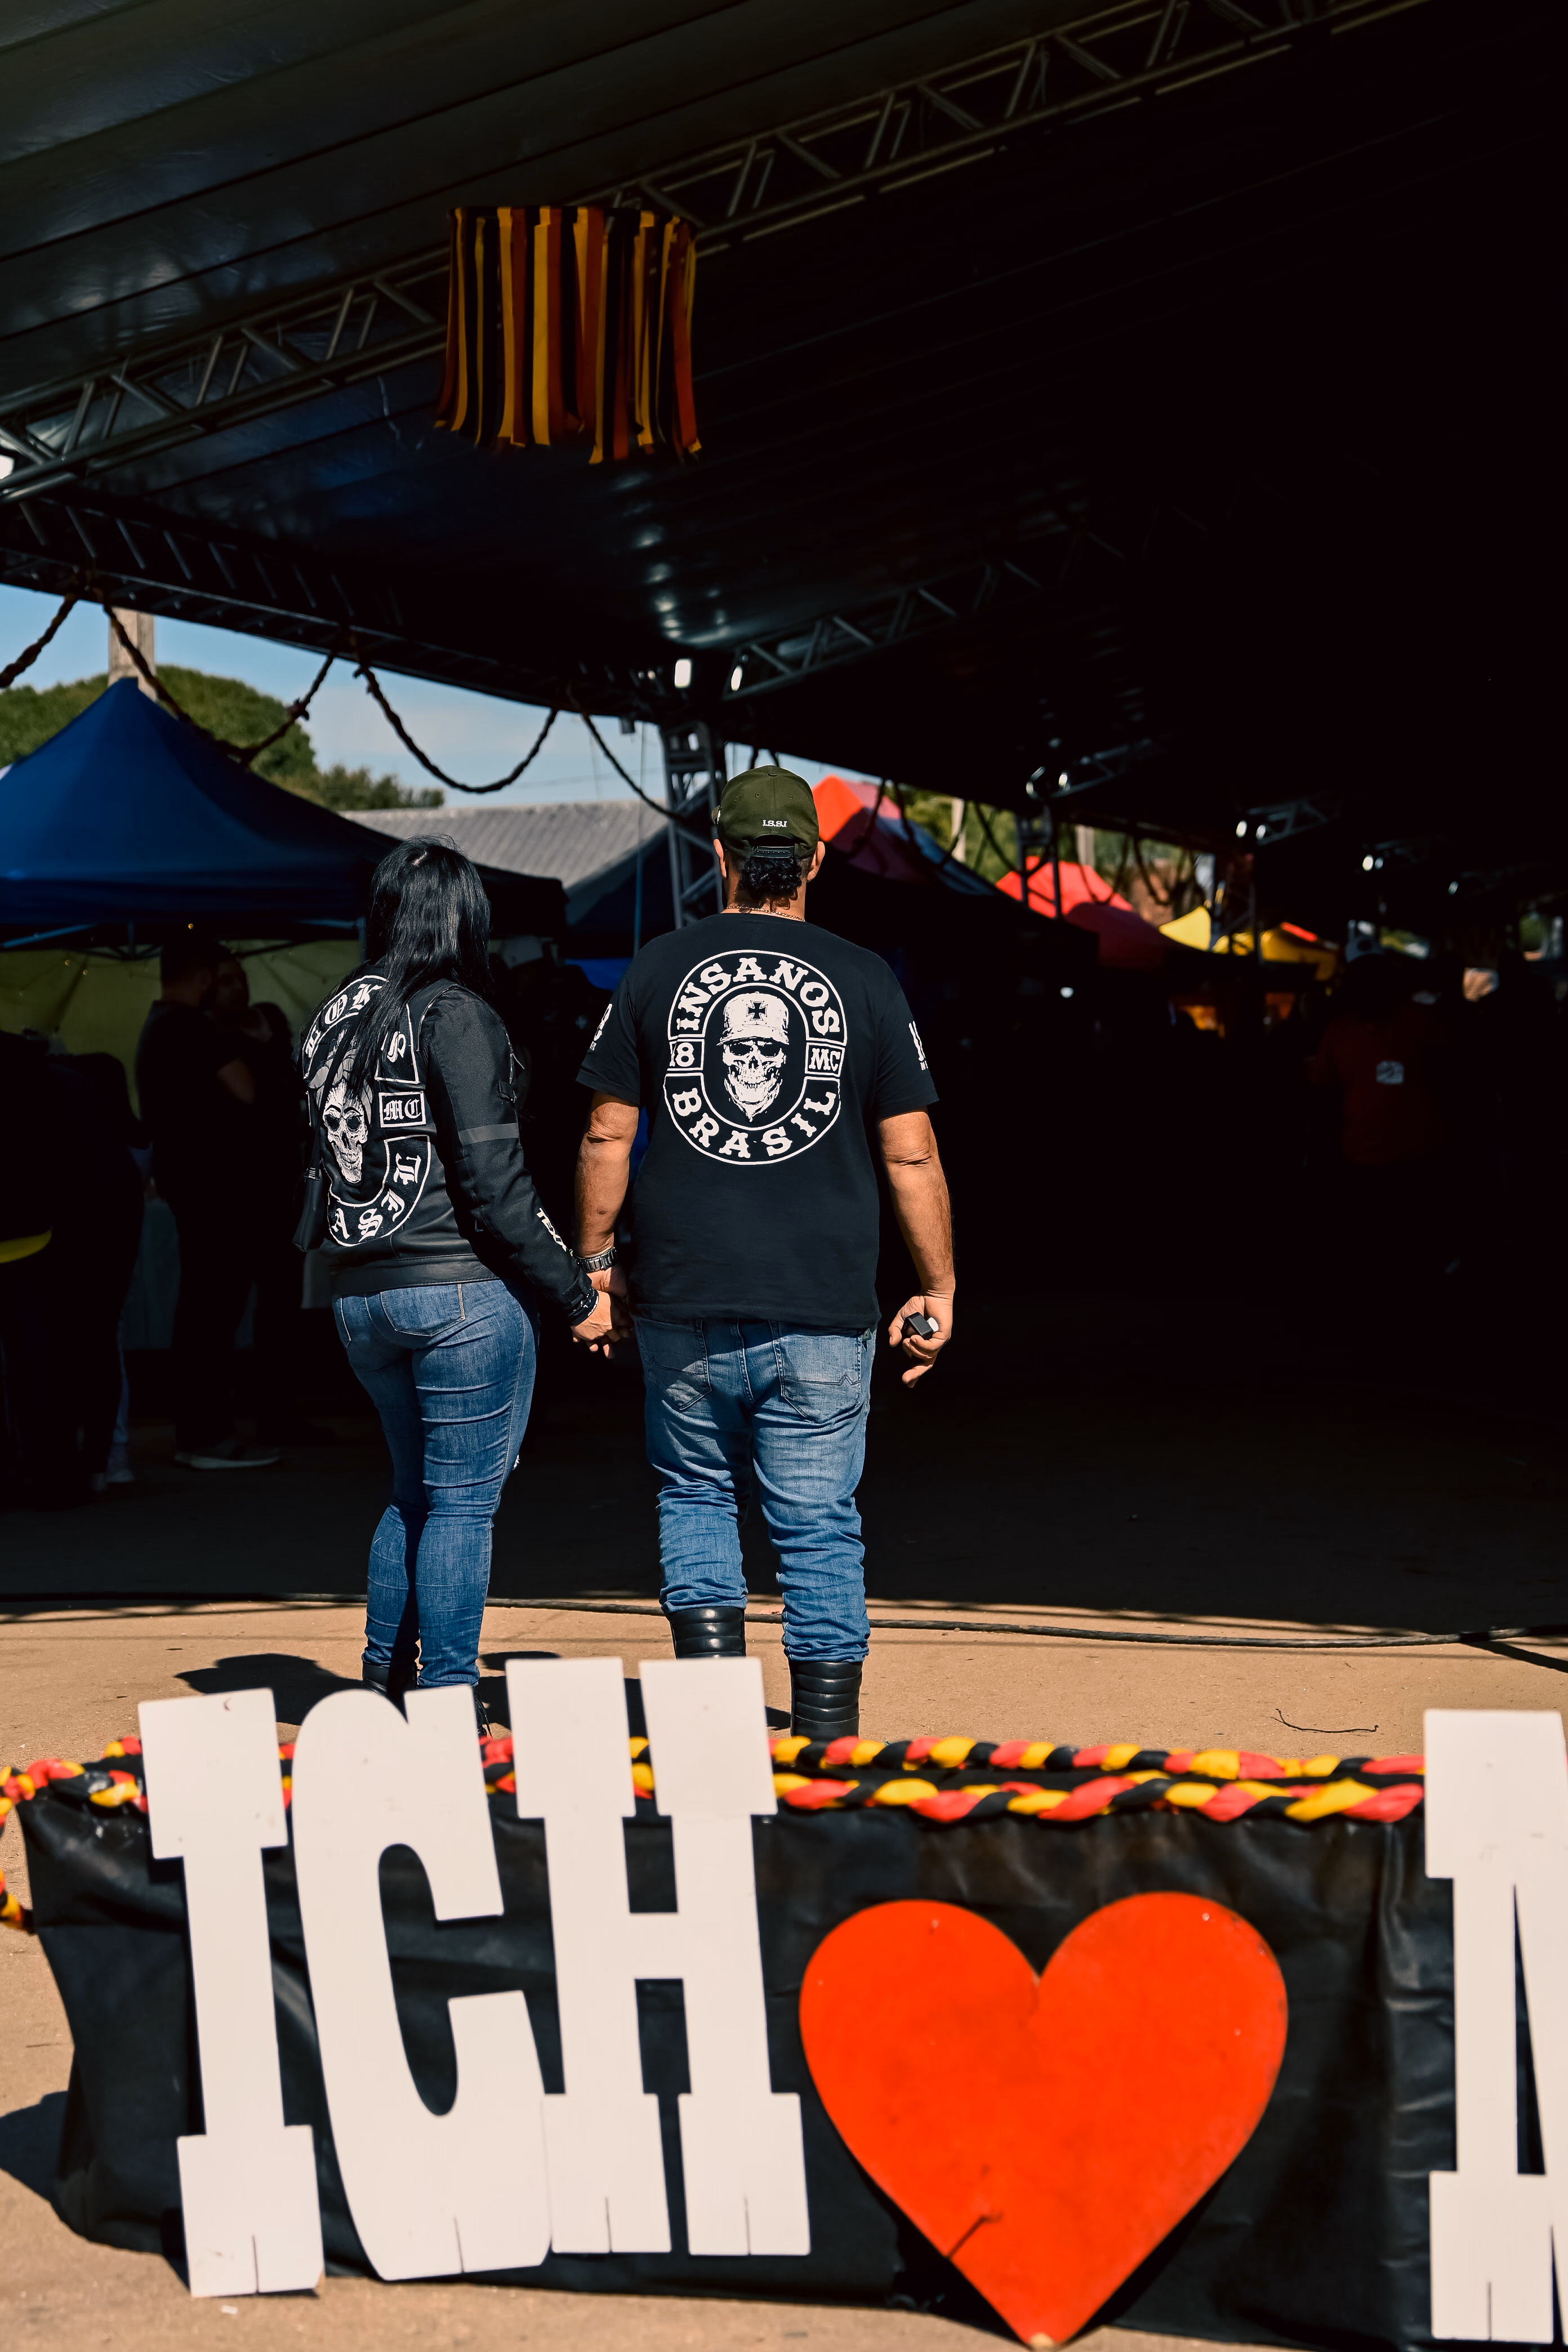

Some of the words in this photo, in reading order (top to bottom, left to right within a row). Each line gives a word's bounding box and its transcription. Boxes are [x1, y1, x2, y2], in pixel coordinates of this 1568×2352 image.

[305, 983, 406, 1063] LOKS
[677, 957, 840, 1036] INSANOS
[809, 1048, 841, 1071] MC
[384, 1099, 421, 1121] MC
[672, 1088, 836, 1159] BRASIL
[139, 1657, 811, 2297] ICH
